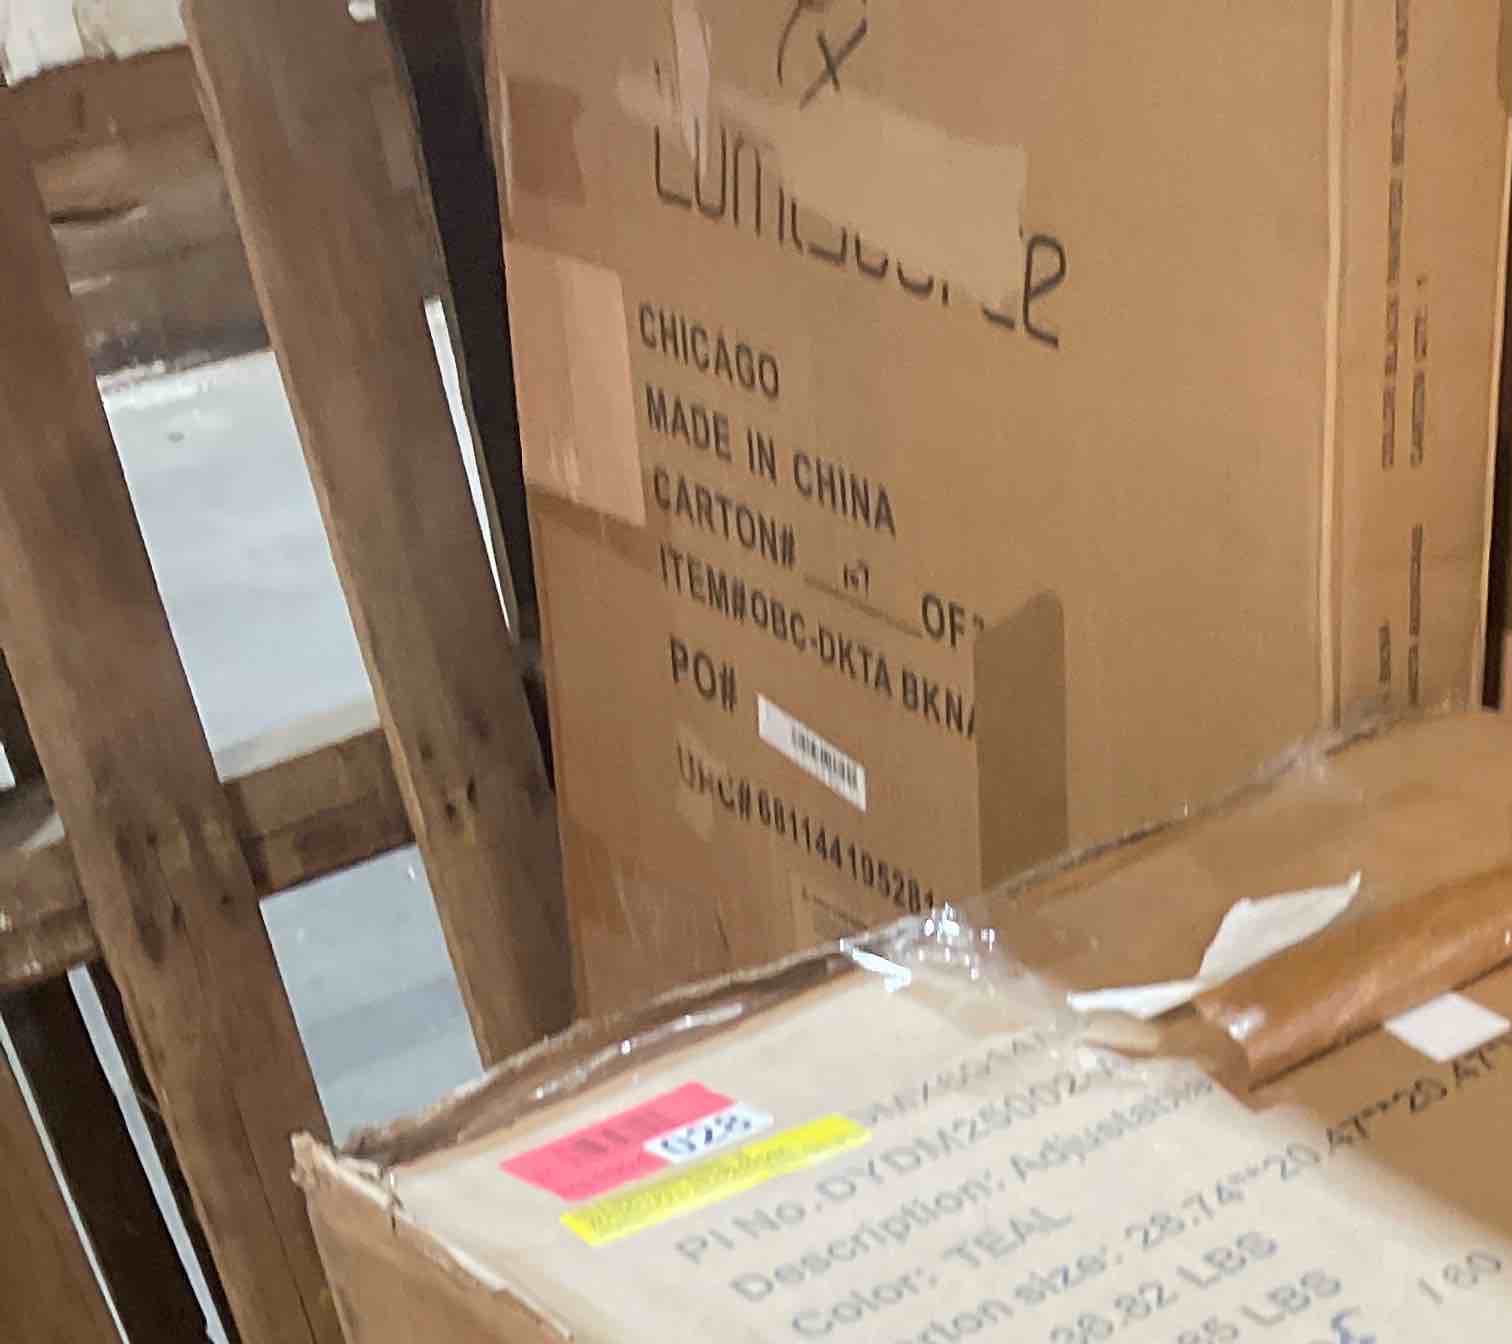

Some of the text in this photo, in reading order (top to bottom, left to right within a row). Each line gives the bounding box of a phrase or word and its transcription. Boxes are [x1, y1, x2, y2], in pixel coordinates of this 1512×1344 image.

[638, 302, 781, 400] CHICAGO
[645, 385, 898, 539] MADE IN CHINA
[653, 466, 797, 571] CARTON#
[669, 632, 739, 714] PO#
[729, 1173, 1005, 1303] Description:
[792, 1205, 1074, 1341] Color: TEAL
[1014, 1241, 1125, 1308] size:
[1176, 1230, 1279, 1290] LBS
[1240, 1268, 1343, 1326] LBS
